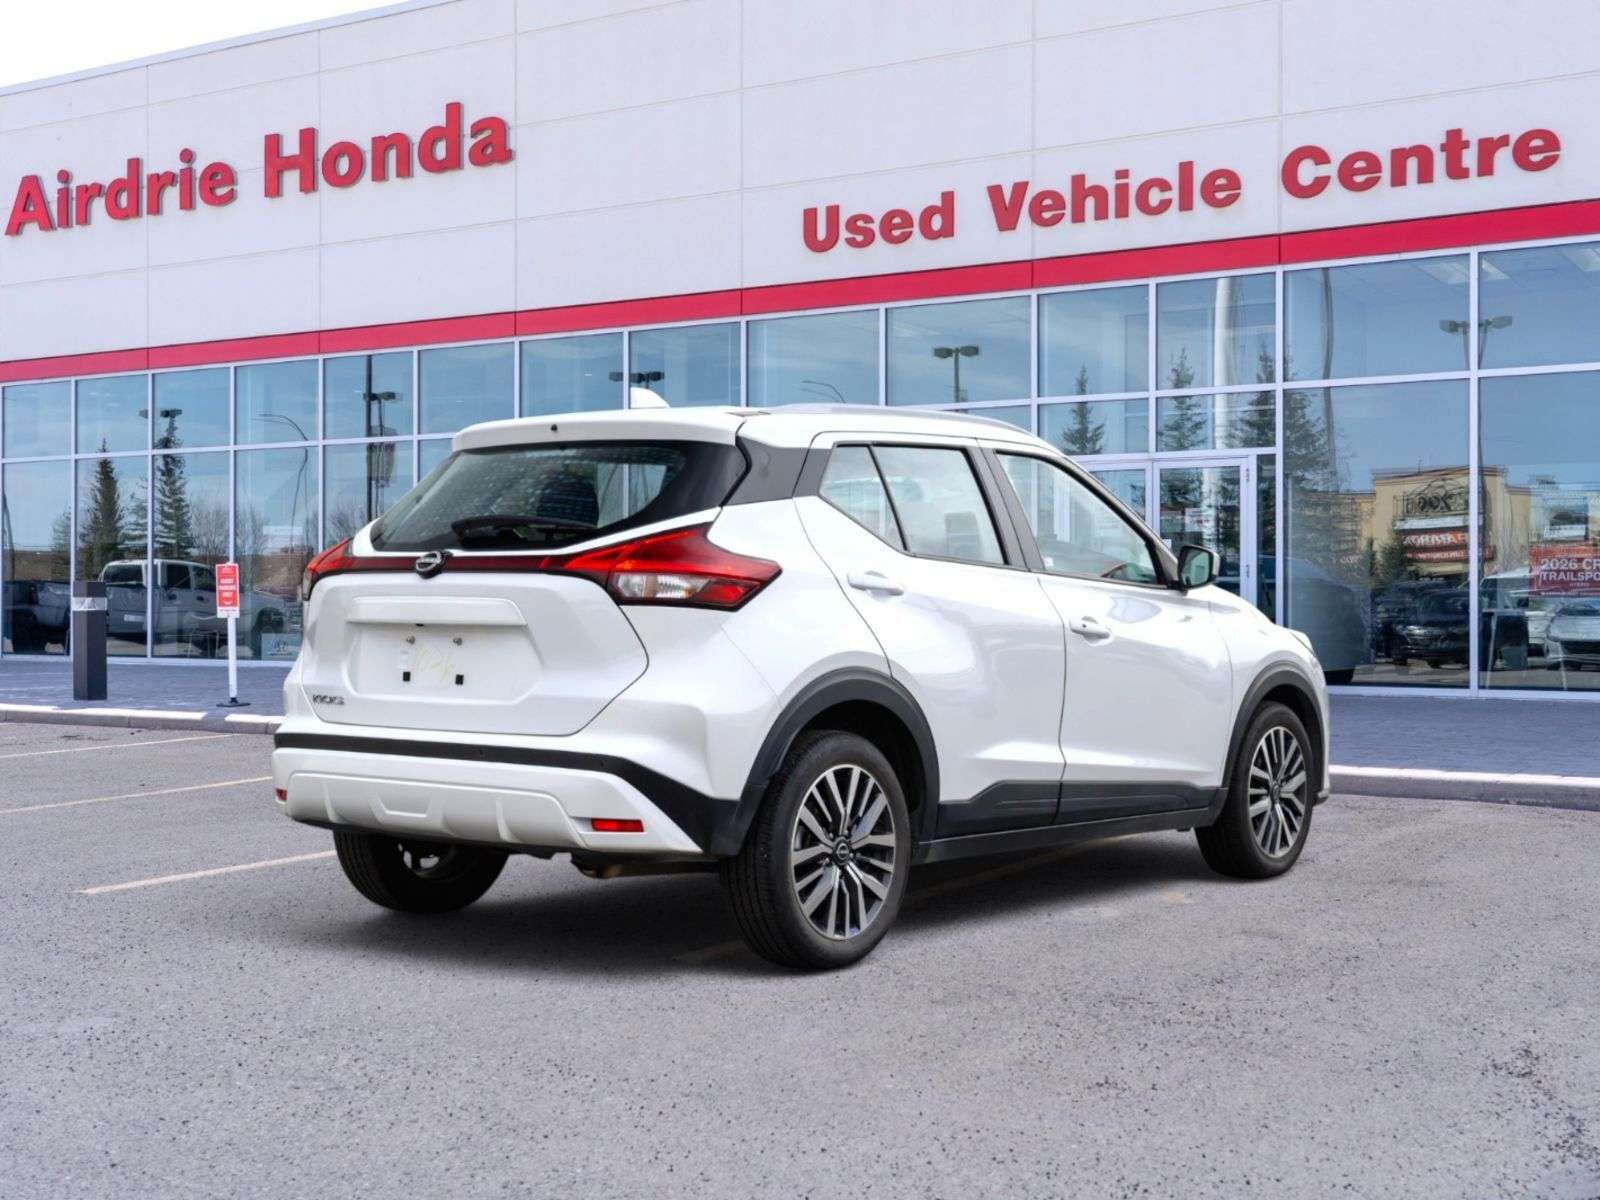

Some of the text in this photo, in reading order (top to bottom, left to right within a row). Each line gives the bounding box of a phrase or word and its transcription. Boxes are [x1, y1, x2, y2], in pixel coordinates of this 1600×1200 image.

[5, 101, 513, 236] Airdrie Honda
[802, 127, 1562, 253] Used Vehicle Centre
[1540, 558, 1578, 570] 2026
